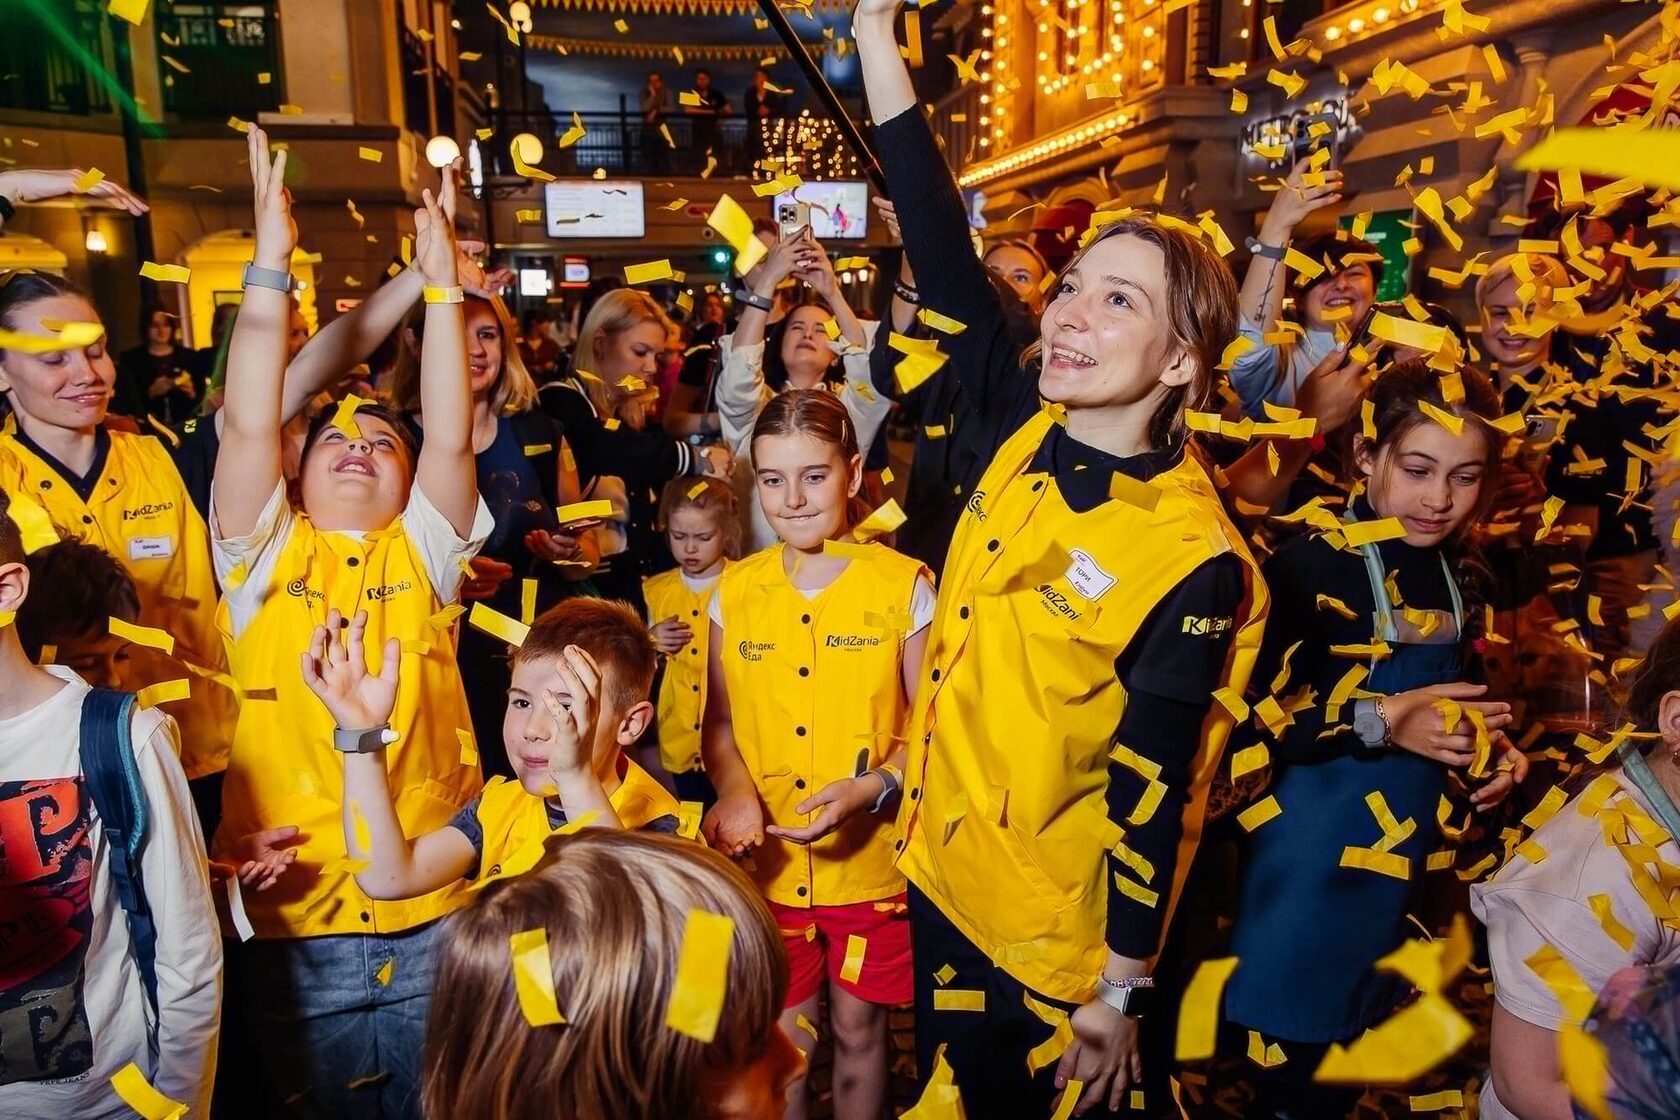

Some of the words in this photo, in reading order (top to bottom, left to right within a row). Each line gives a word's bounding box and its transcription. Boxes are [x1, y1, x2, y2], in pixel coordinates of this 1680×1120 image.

[1033, 584, 1082, 621] idZani
[748, 641, 775, 651] Яндекс
[826, 634, 879, 648] KidZania
[748, 652, 762, 662] Еда
[63, 1072, 90, 1085] JEANS
